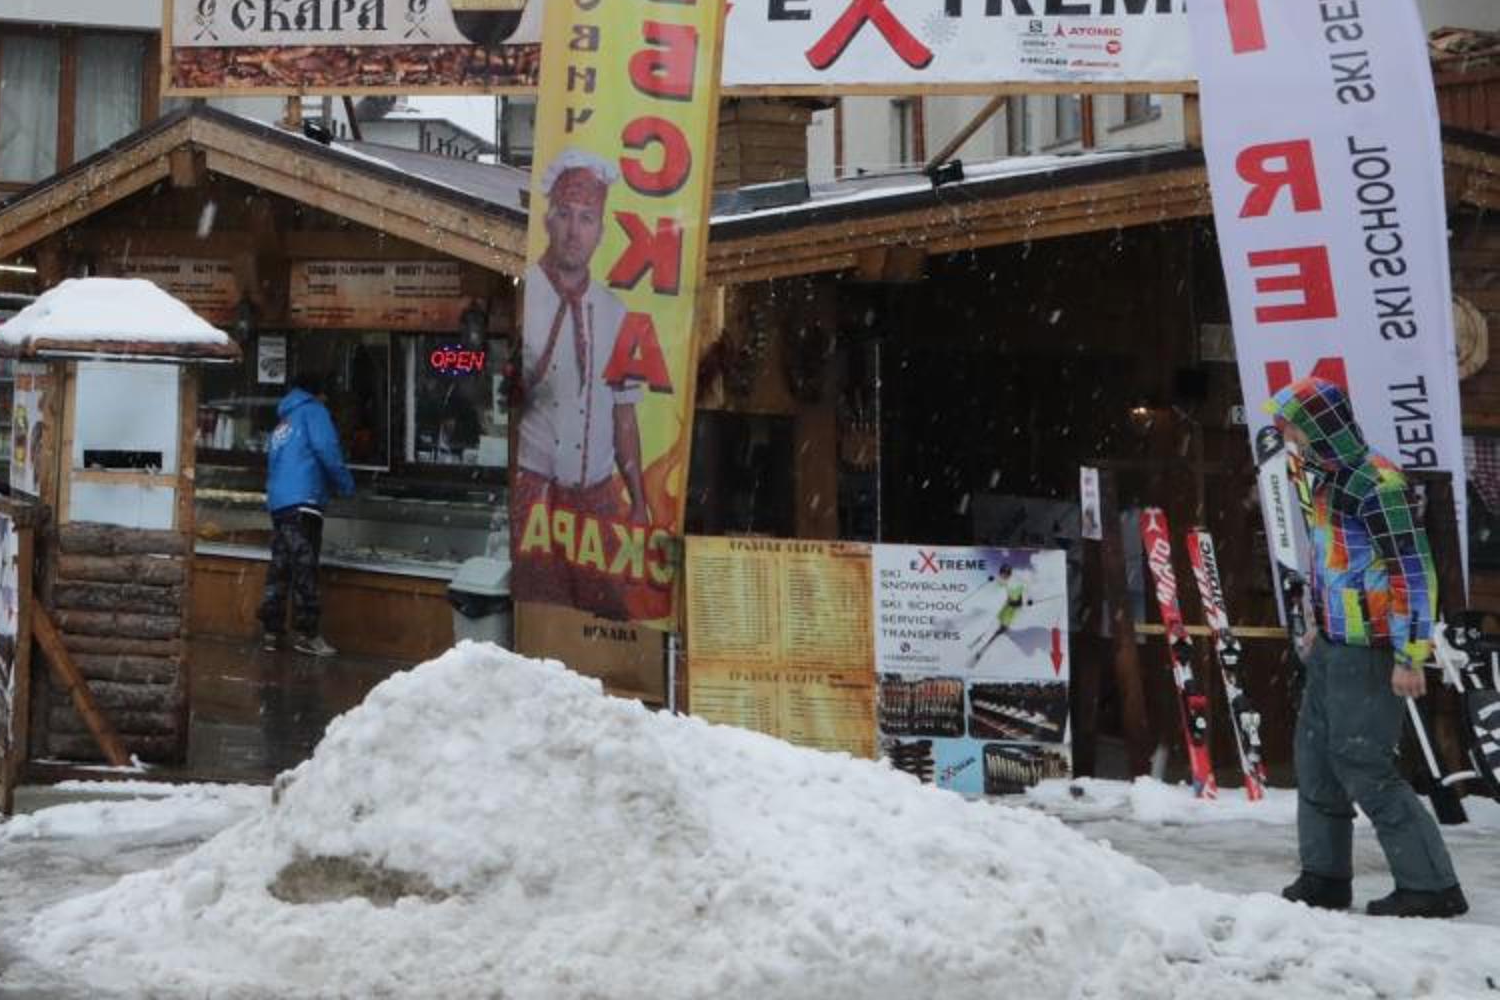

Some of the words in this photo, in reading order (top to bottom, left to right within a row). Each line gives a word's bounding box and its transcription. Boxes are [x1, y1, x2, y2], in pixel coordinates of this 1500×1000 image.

[430, 351, 485, 371] OPEN
[910, 551, 988, 573] EXTREME
[881, 582, 967, 593] SNOWBOARD
[882, 600, 901, 610] SKI
[907, 601, 964, 612] SCHOOL
[882, 615, 934, 625] SERVICE
[882, 629, 961, 641] TRANSFERS
